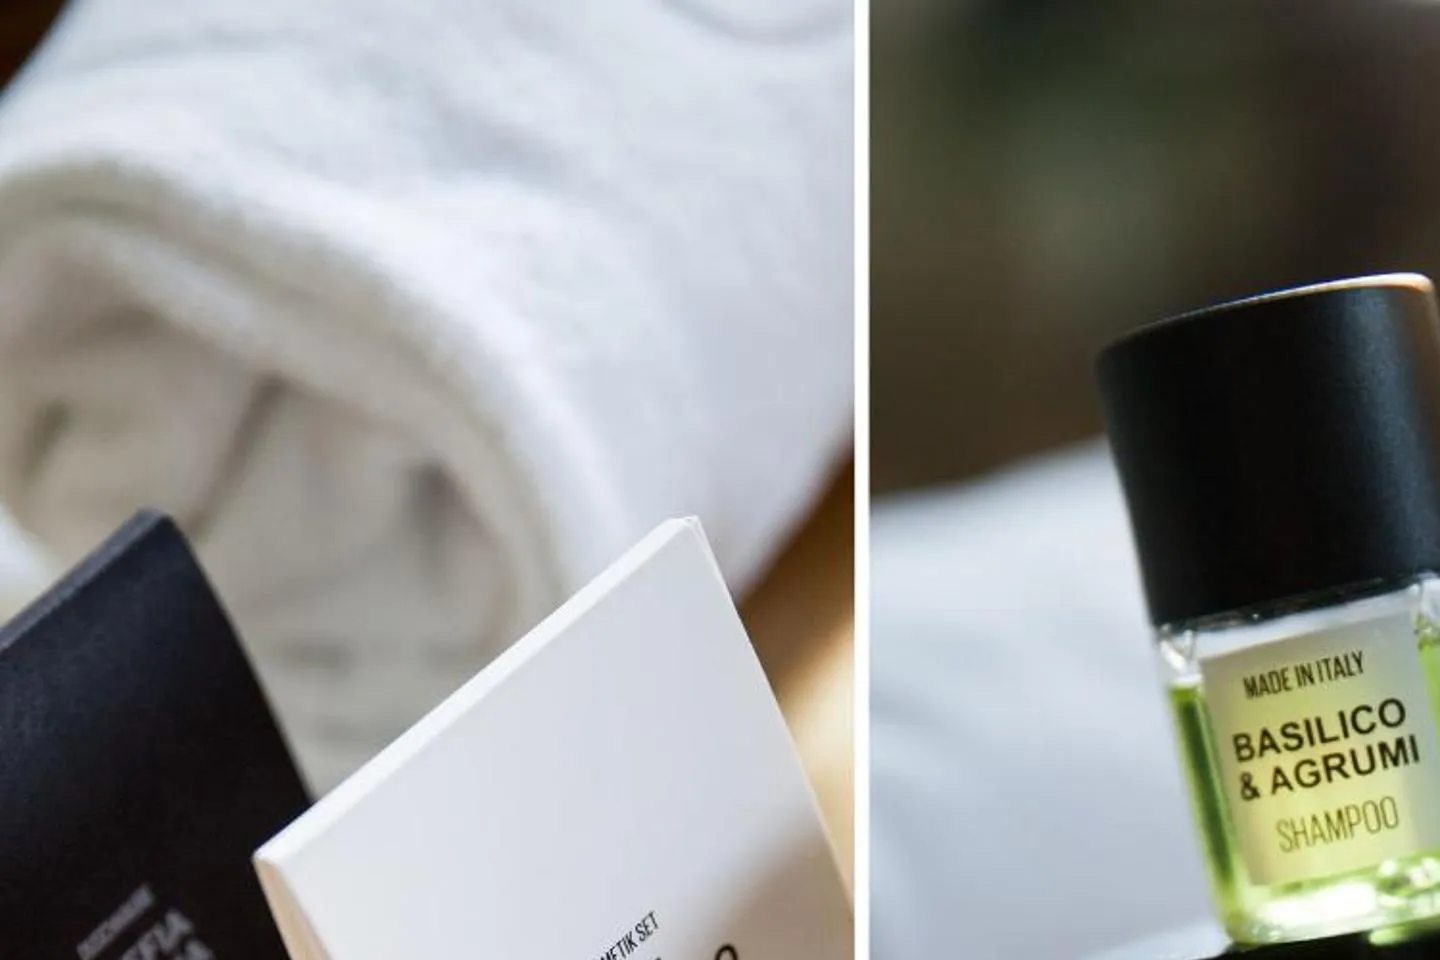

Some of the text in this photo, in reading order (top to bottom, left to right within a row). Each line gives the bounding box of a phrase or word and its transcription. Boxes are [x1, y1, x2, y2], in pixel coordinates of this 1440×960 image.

[1243, 650, 1364, 699] MADE IN ITALY
[1232, 697, 1406, 763] BASILICO
[1240, 734, 1420, 801] & AGRUMI
[1276, 796, 1399, 852] SHAMPOO
[634, 910, 660, 942] SET
